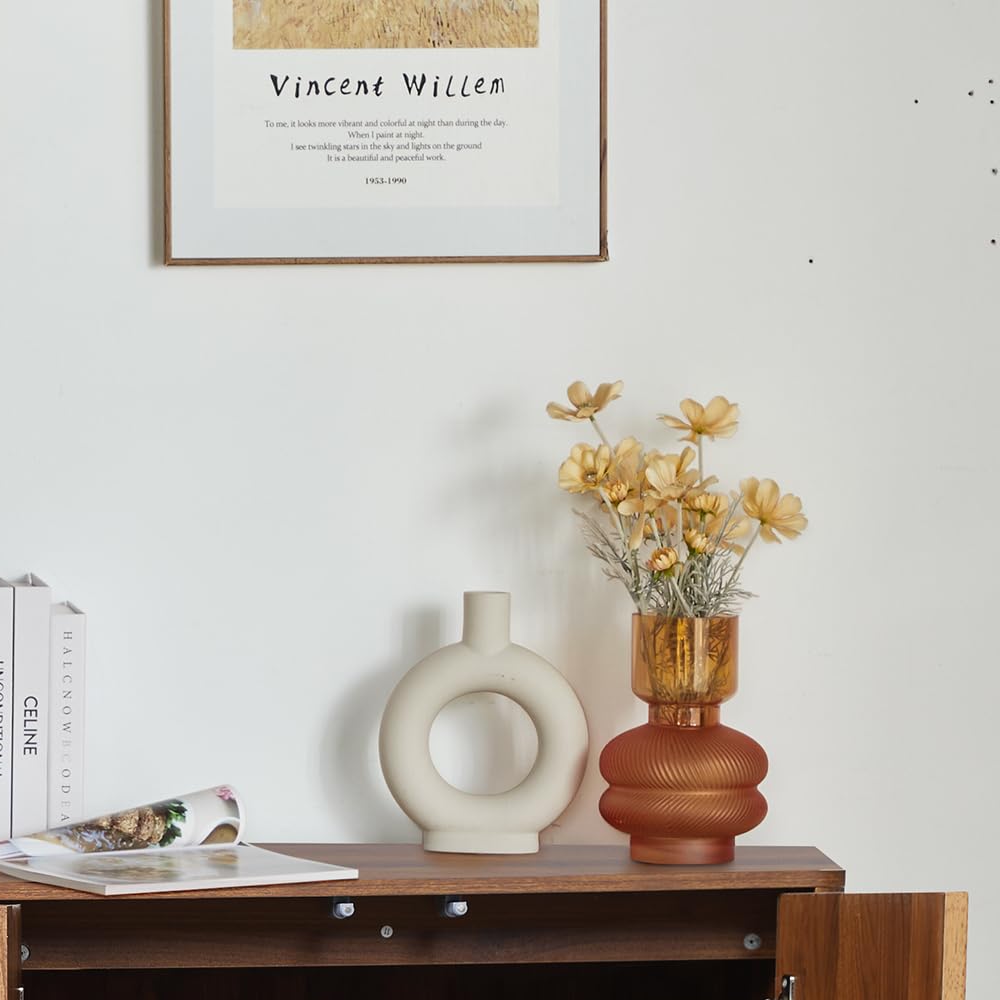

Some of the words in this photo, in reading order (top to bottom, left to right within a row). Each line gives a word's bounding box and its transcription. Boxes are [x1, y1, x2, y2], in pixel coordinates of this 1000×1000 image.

[270, 74, 384, 98] Vincent
[402, 72, 505, 98] Willem
[265, 120, 274, 128] To
[380, 119, 406, 127] colorful
[417, 119, 435, 128] night
[455, 119, 478, 128] during
[481, 118, 491, 126] the
[494, 118, 508, 128] day.
[348, 130, 369, 138] When
[376, 132, 393, 140] paint
[404, 130, 424, 140] night.
[308, 142, 341, 152] twinkling
[361, 142, 367, 150] in
[370, 141, 381, 150] the
[383, 142, 394, 152] sky
[396, 142, 409, 150] and
[412, 142, 430, 152] lights
[444, 142, 454, 150] the
[456, 141, 482, 151] ground
[348, 153, 378, 161] beautiful
[395, 153, 424, 163] peaceful
[24, 696, 38, 755] CELINE
